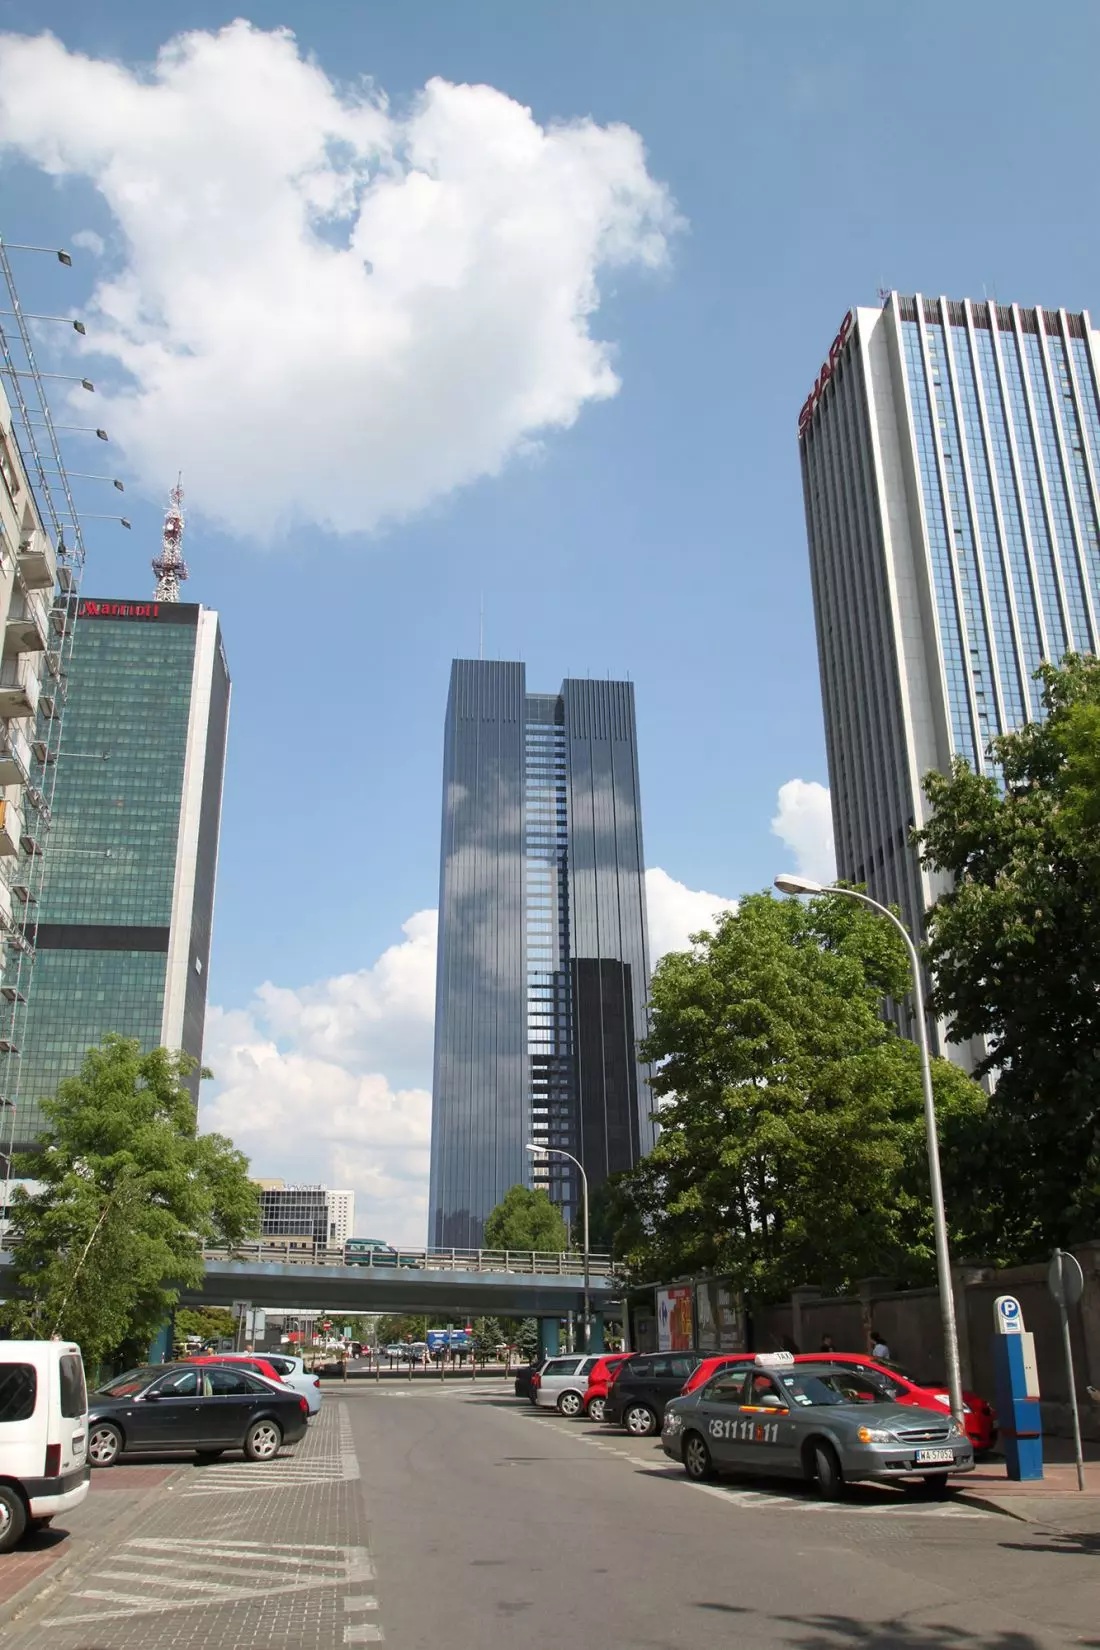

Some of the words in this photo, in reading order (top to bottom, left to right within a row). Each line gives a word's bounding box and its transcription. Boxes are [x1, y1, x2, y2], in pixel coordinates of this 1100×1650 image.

[79, 600, 160, 618] Marriott
[1004, 1301, 1016, 1316] P
[775, 1352, 793, 1361] TAXI
